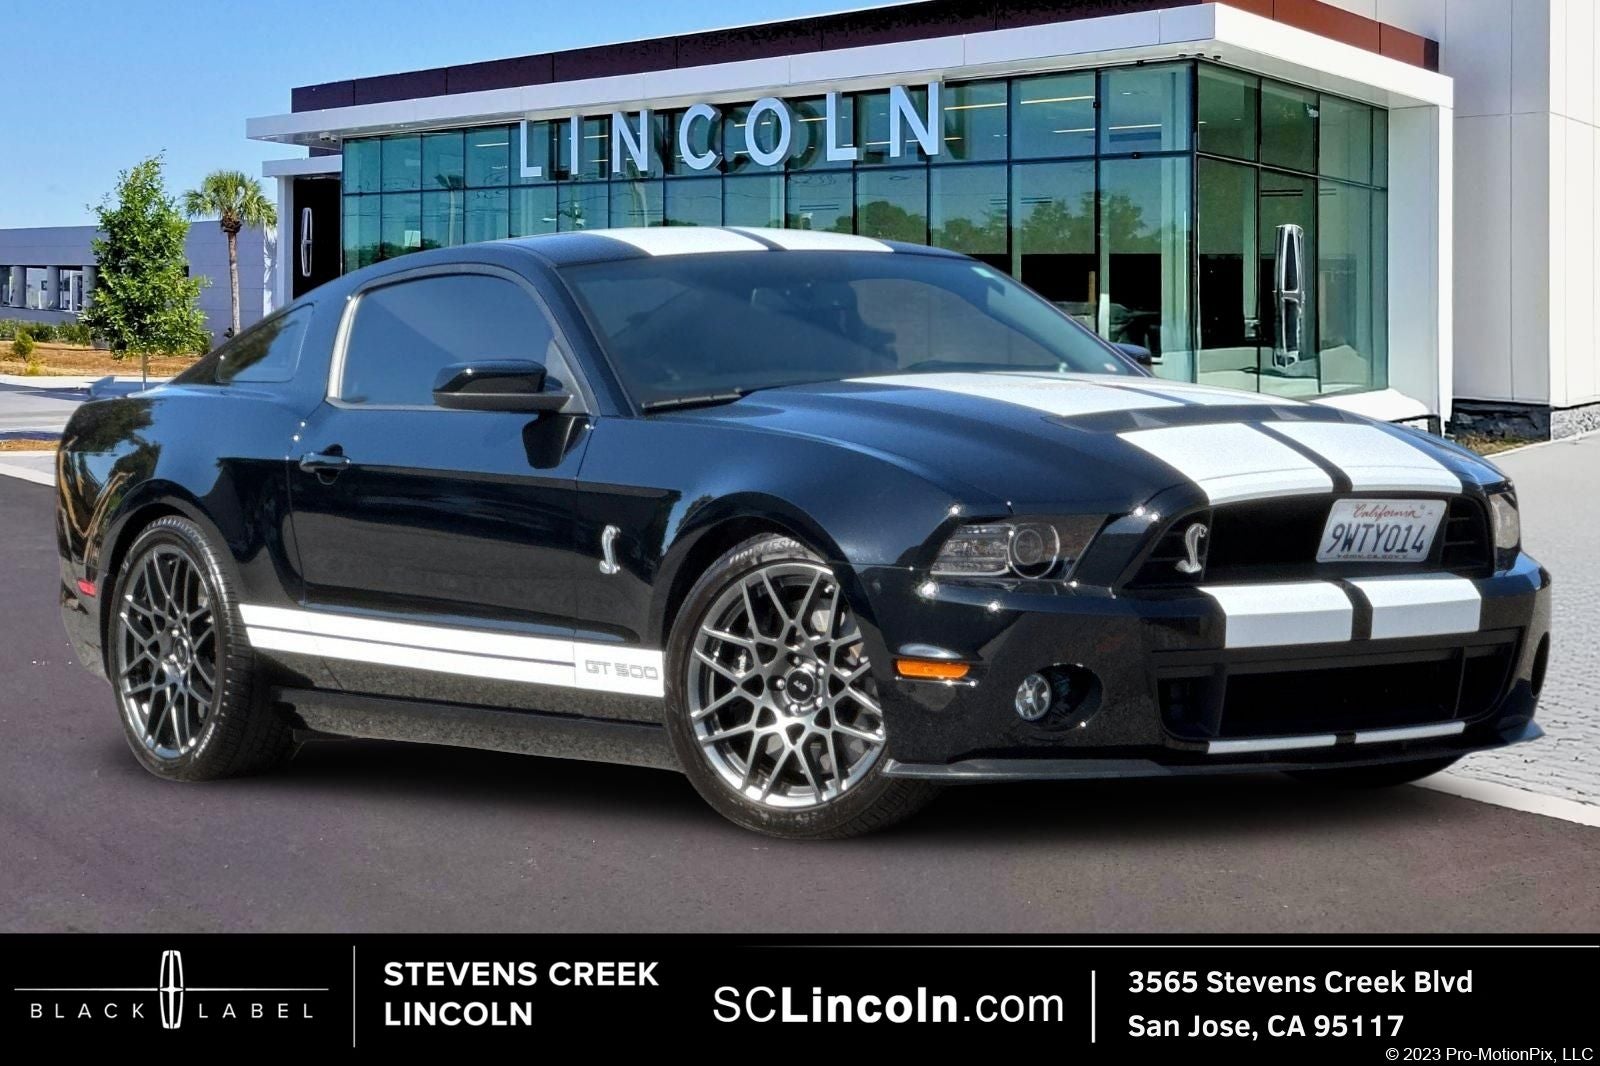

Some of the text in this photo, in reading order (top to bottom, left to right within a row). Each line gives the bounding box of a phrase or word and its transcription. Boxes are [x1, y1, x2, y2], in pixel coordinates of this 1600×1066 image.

[519, 81, 944, 178] LINCOLN
[1353, 504, 1421, 521] California
[1326, 522, 1426, 554] 9WTY014
[585, 659, 659, 680] GT 500
